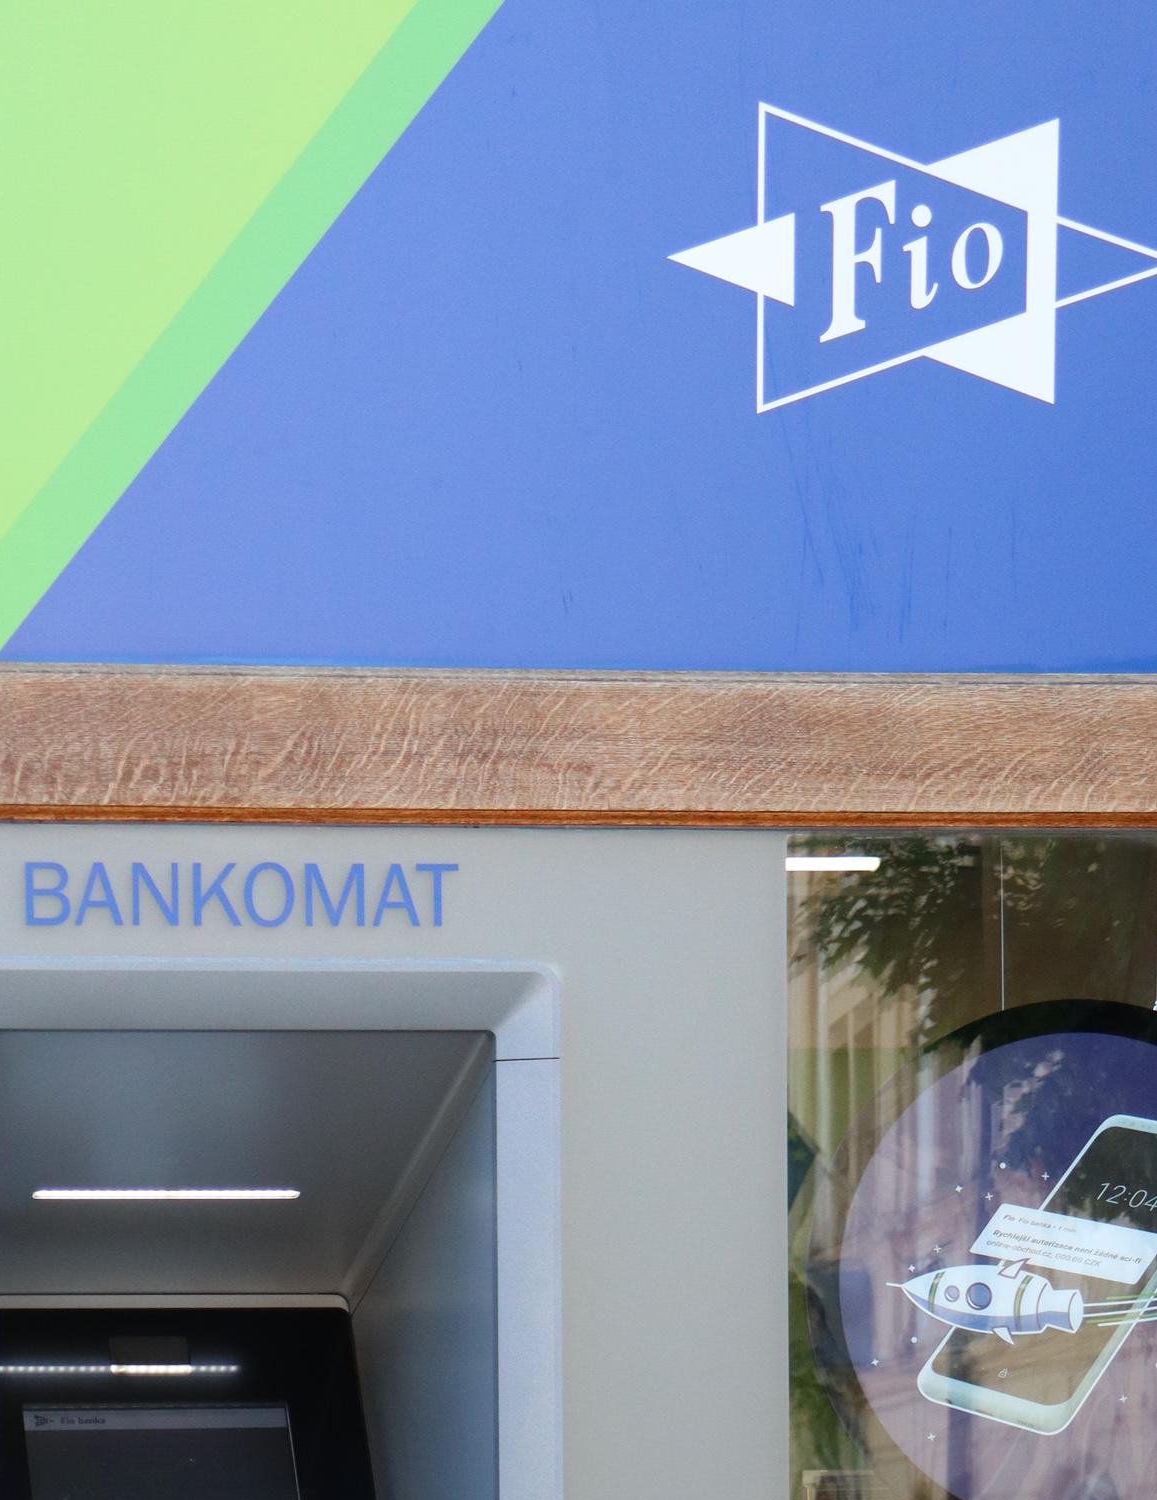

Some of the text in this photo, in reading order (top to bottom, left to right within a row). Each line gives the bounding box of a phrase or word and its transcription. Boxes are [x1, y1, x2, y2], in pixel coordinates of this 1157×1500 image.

[820, 179, 1004, 343] Fio
[24, 861, 460, 928] BANKOMAT
[1096, 1182, 1157, 1212] 12:04
[1031, 1238, 1073, 1250] autorizace
